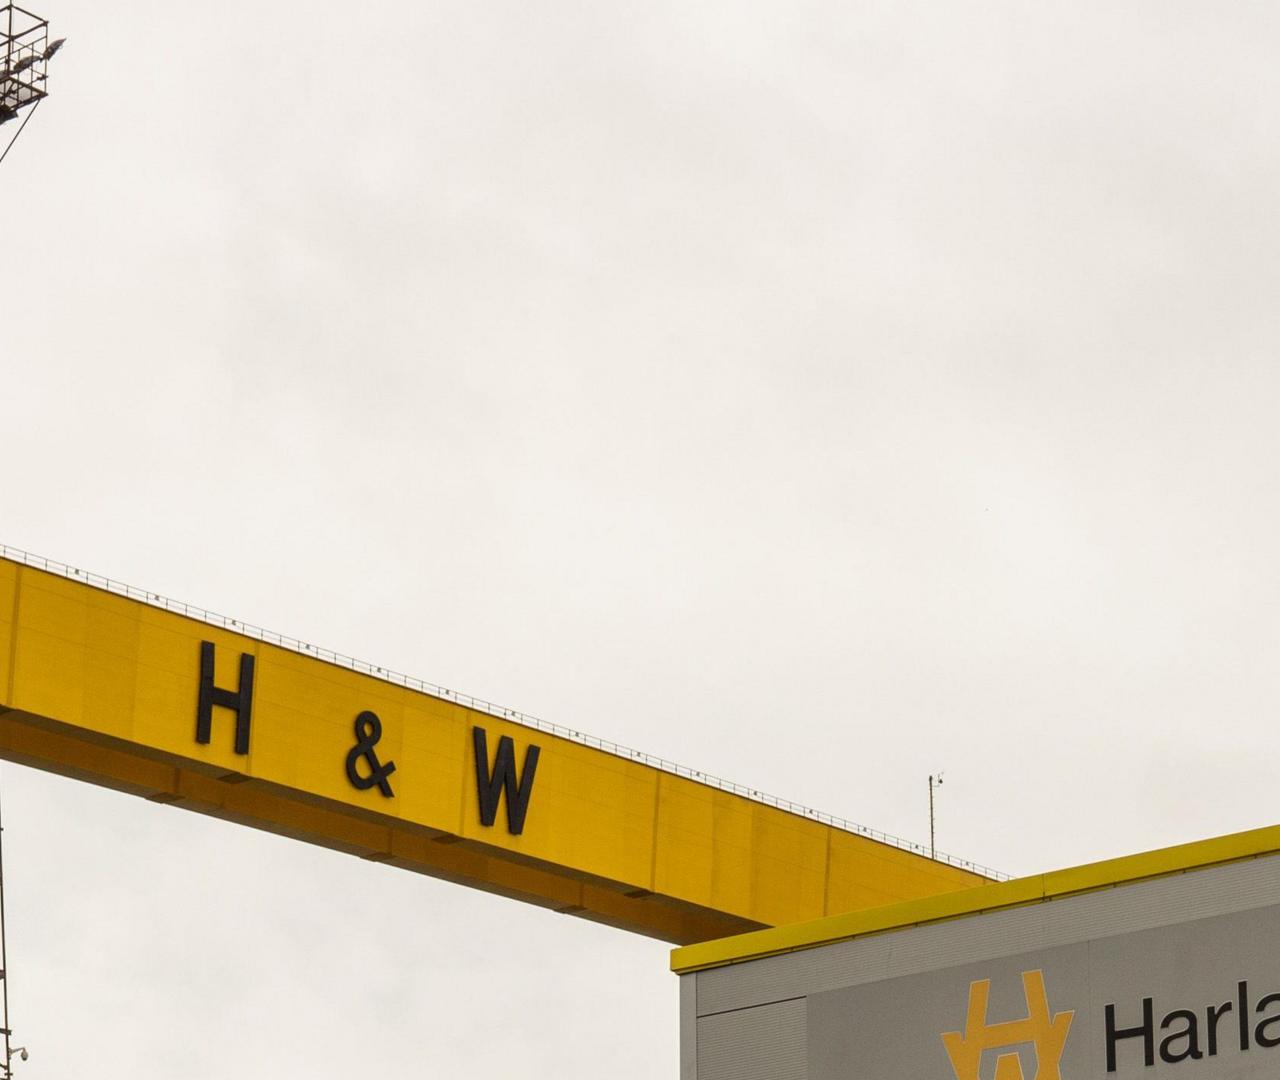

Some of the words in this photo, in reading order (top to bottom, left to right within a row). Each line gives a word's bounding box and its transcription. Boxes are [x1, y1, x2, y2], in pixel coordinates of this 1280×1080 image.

[196, 640, 255, 755] H
[346, 710, 397, 798] &
[473, 726, 541, 835] W
